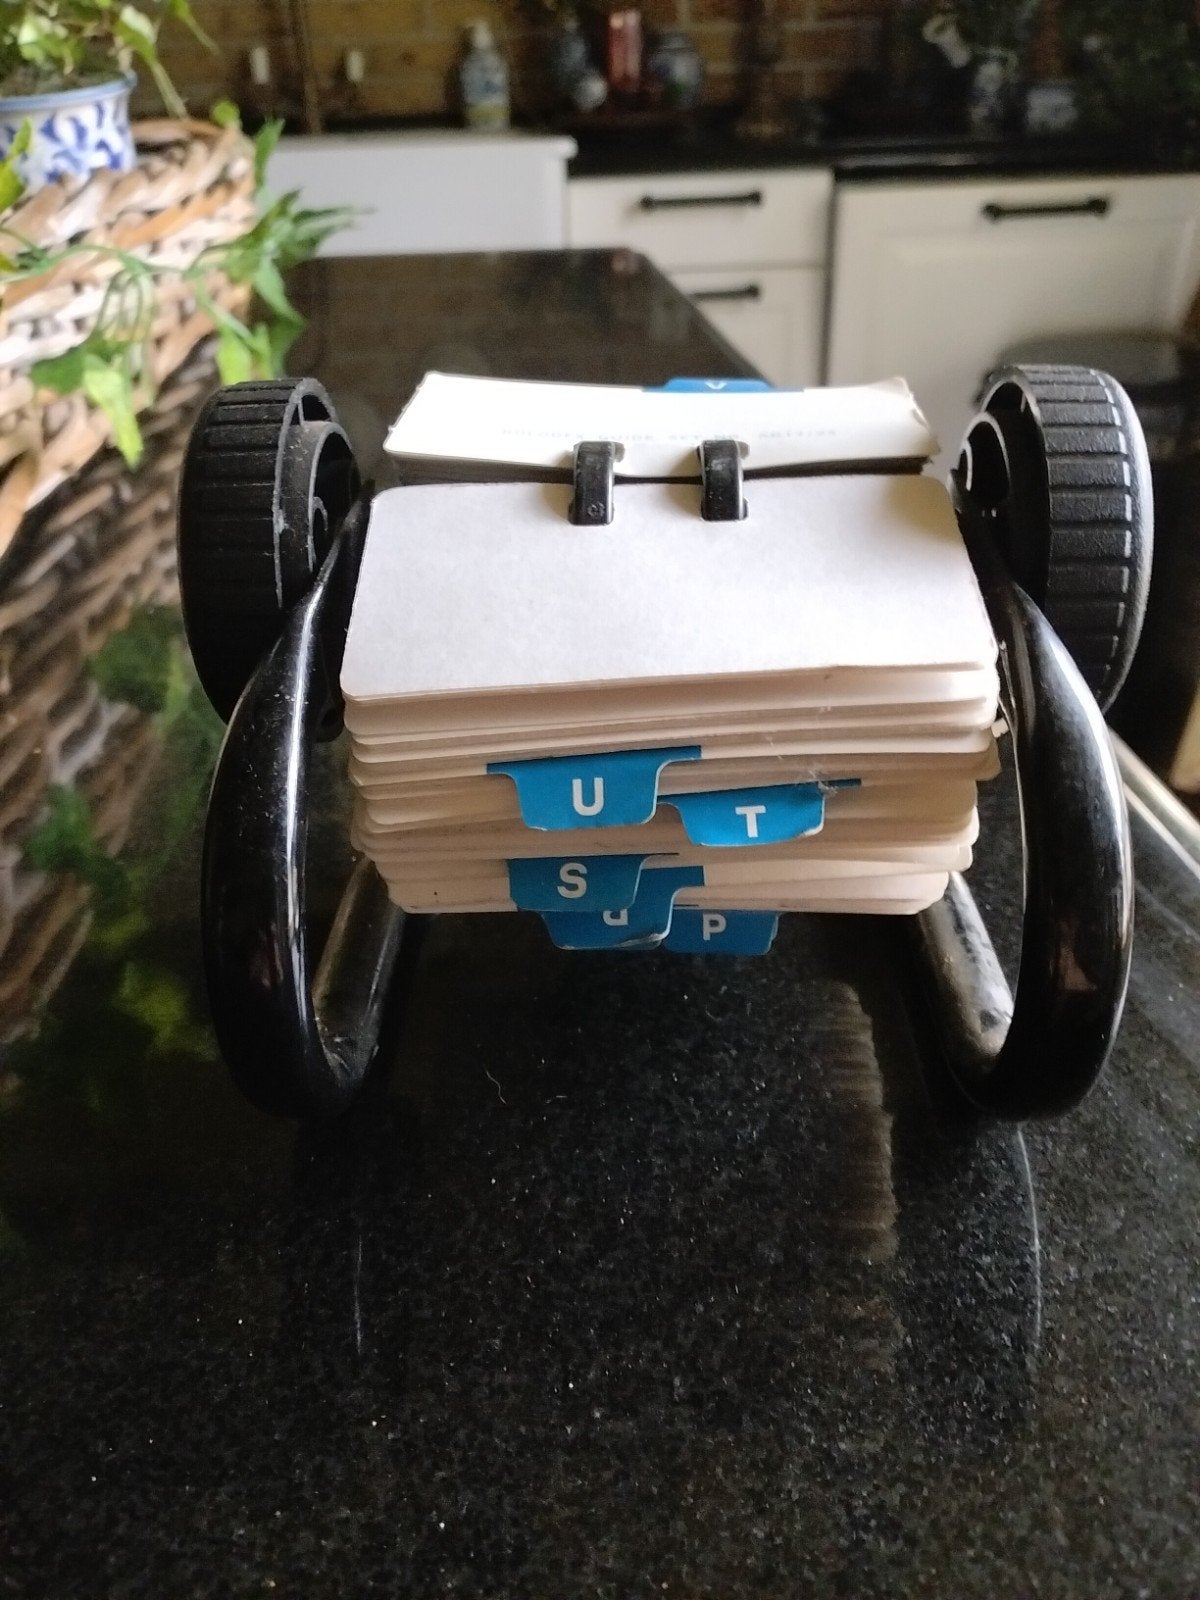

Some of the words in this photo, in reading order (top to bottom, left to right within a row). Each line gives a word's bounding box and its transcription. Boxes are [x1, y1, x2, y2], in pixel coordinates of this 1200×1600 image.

[702, 378, 729, 390] V
[572, 777, 604, 816] U
[735, 805, 766, 838] T
[557, 862, 588, 898] S
[702, 914, 727, 941] P
